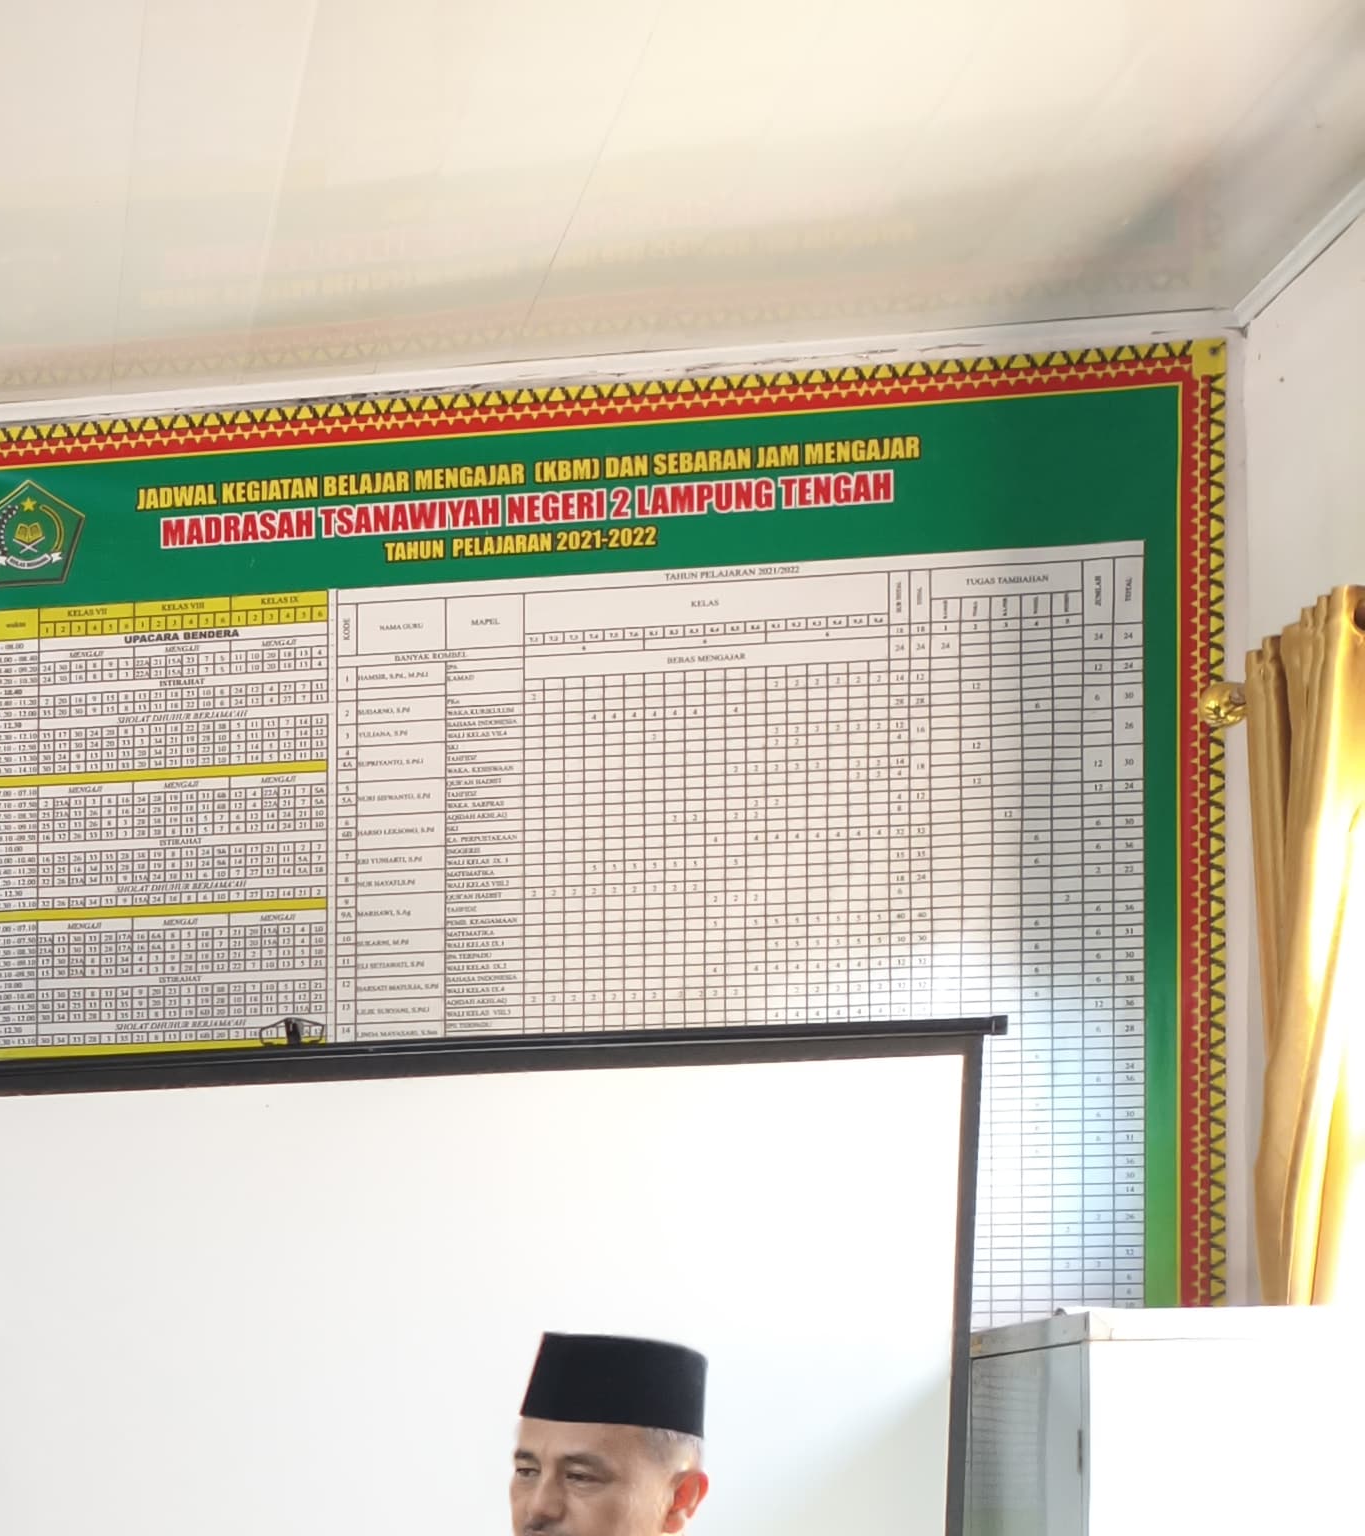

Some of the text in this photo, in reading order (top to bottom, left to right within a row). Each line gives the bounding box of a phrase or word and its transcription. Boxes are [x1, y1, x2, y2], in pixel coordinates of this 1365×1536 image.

[137, 436, 920, 511] JADWAL KEGIATAN BELAJAR MENGAJAR (KBM) DAN SEBARAN JAM MENGAJAR
[162, 471, 893, 547] MADRASAH TSANAWIYAH NEGERI 2 LAMPUNG TENGAH
[385, 526, 657, 562] TAHUN PELAJARAN 2021-2022
[664, 565, 800, 581] TAHUN PELAJARAN 2021/2022
[965, 574, 1049, 586] TUGAS TAMBAHAN
[691, 599, 719, 608] KELAS
[125, 629, 239, 644] UPACARA BENDERA
